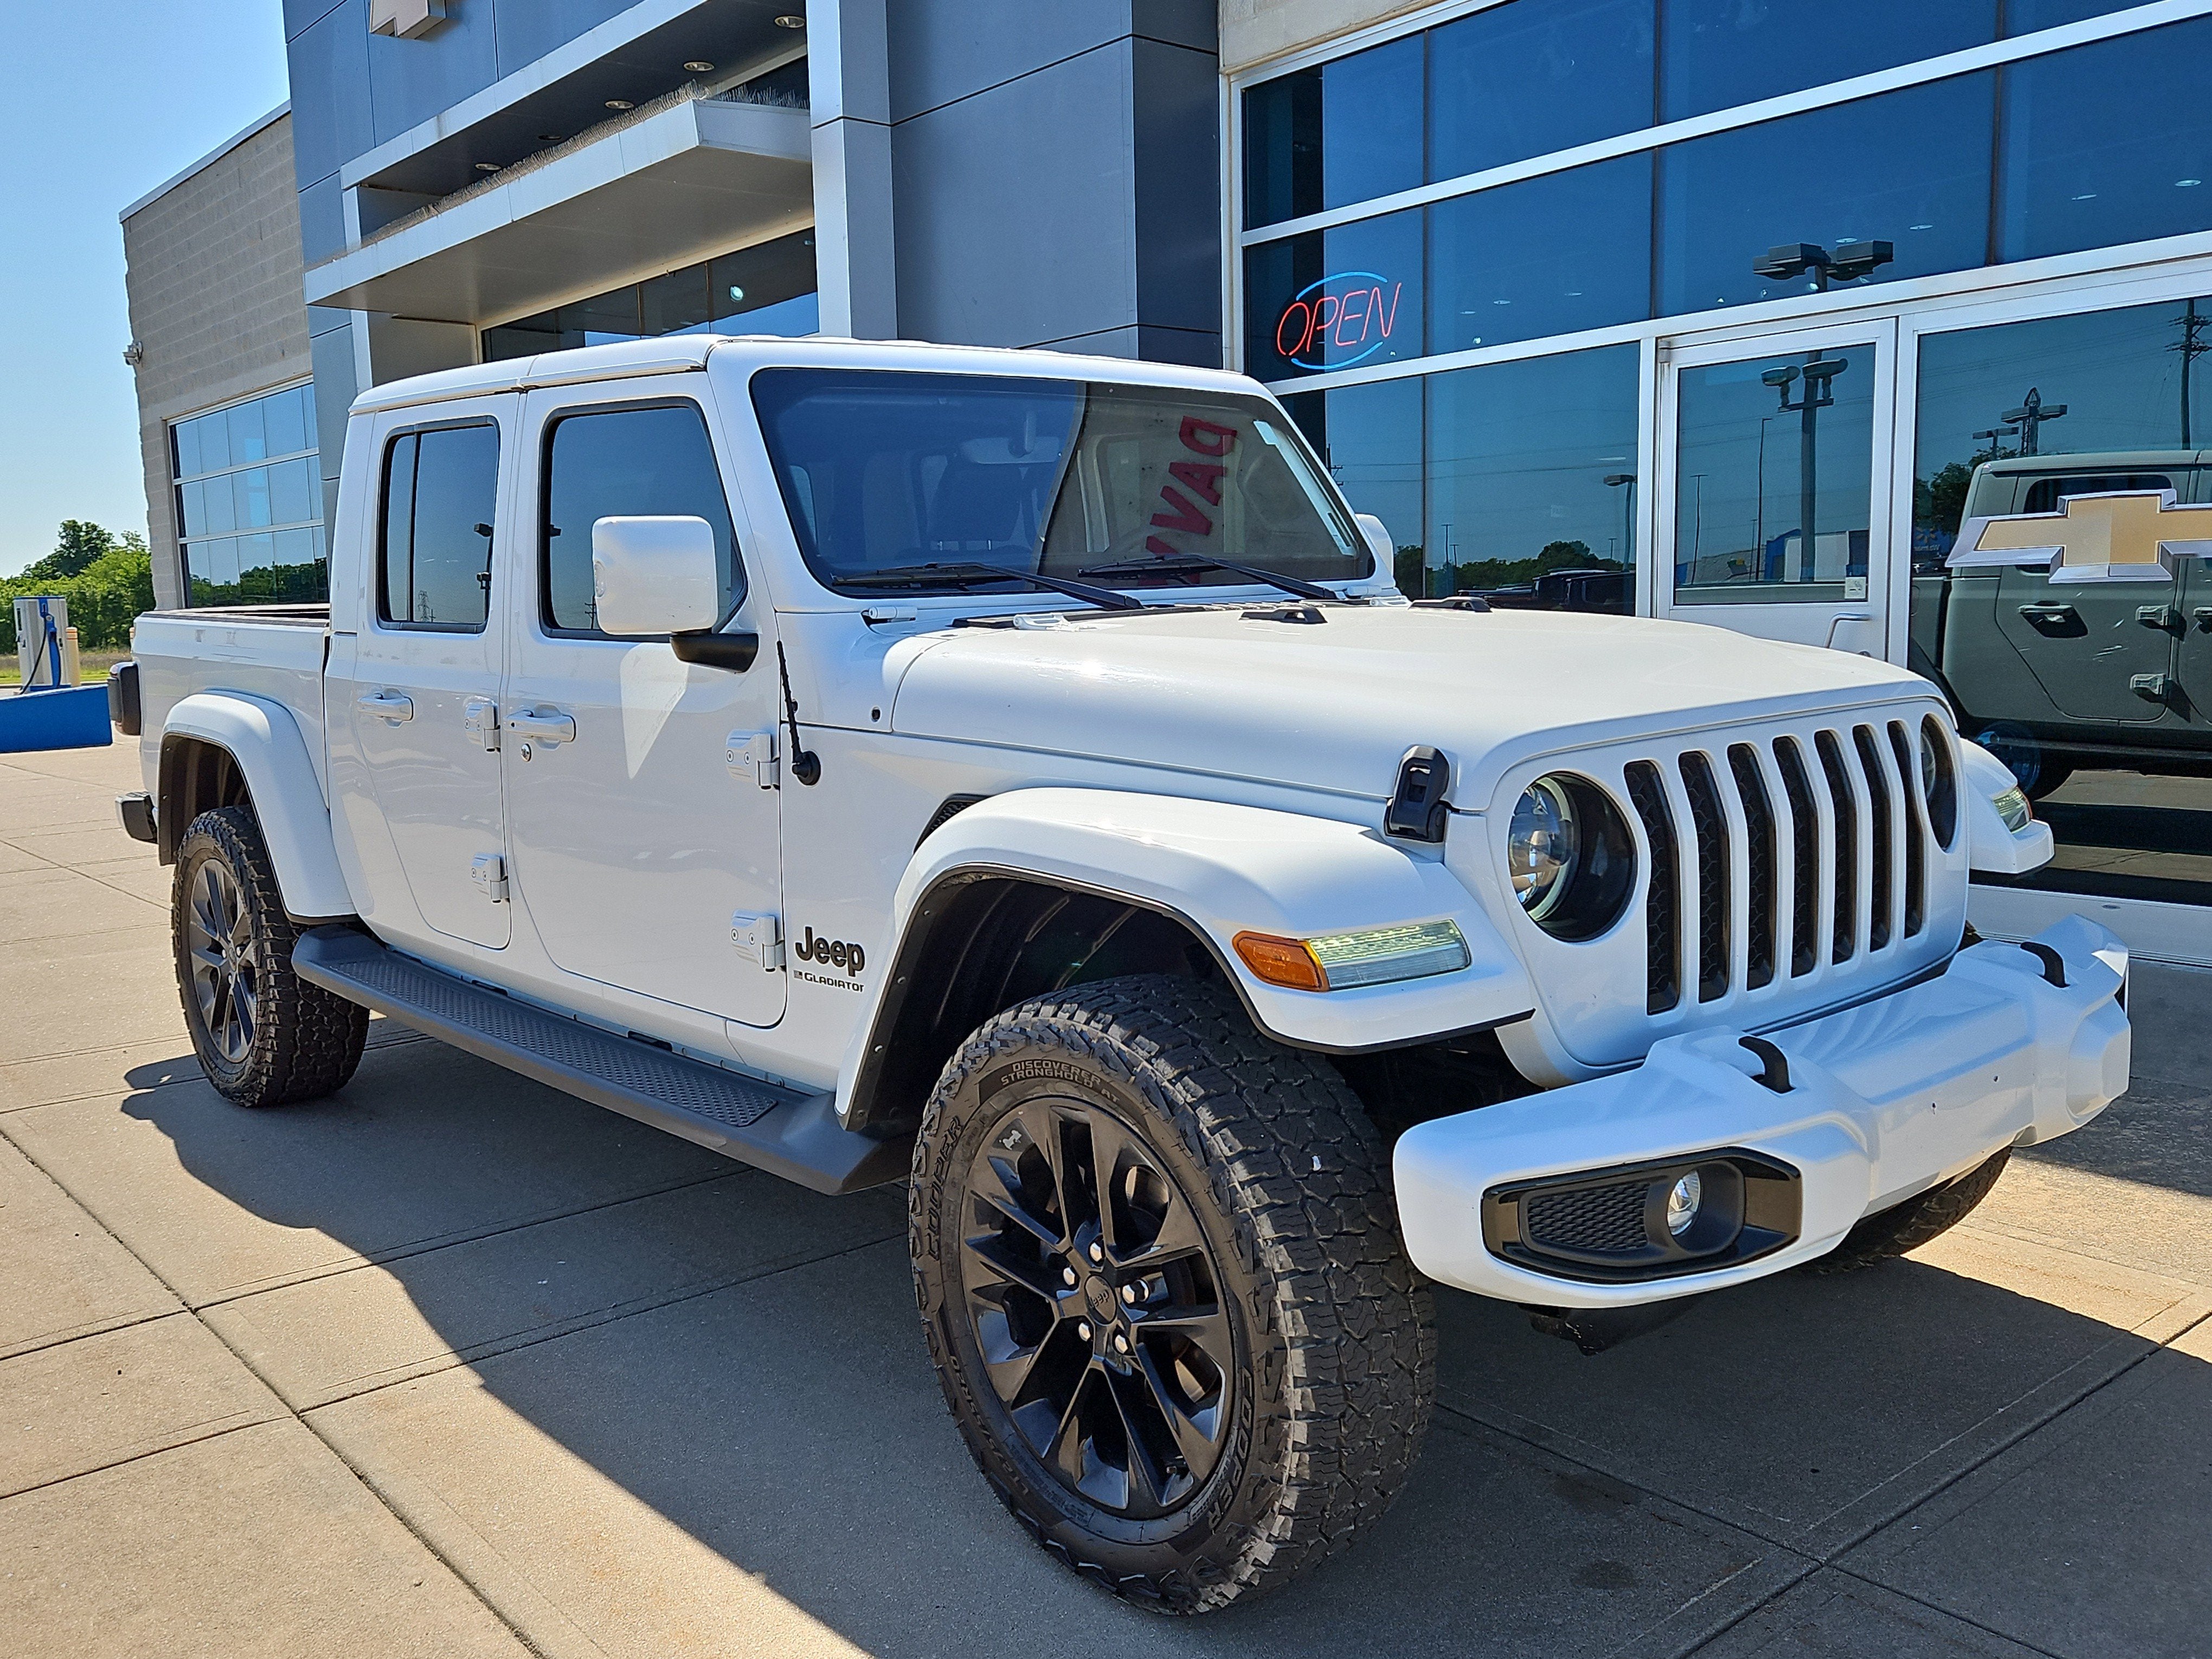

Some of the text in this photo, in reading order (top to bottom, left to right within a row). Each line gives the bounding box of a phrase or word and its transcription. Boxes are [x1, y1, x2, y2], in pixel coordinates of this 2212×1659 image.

[1277, 282, 1401, 356] OPEN
[795, 926, 865, 977] Jeep
[805, 972, 864, 992] GLADIATOR
[1001, 1068, 1121, 1103] STRONGHOLD AT
[1012, 1060, 1102, 1085] DISCOVERER
[927, 1115, 964, 1262] COOPER
[1089, 1289, 1110, 1308] Jeep
[1208, 1365, 1253, 1531] COOPER
